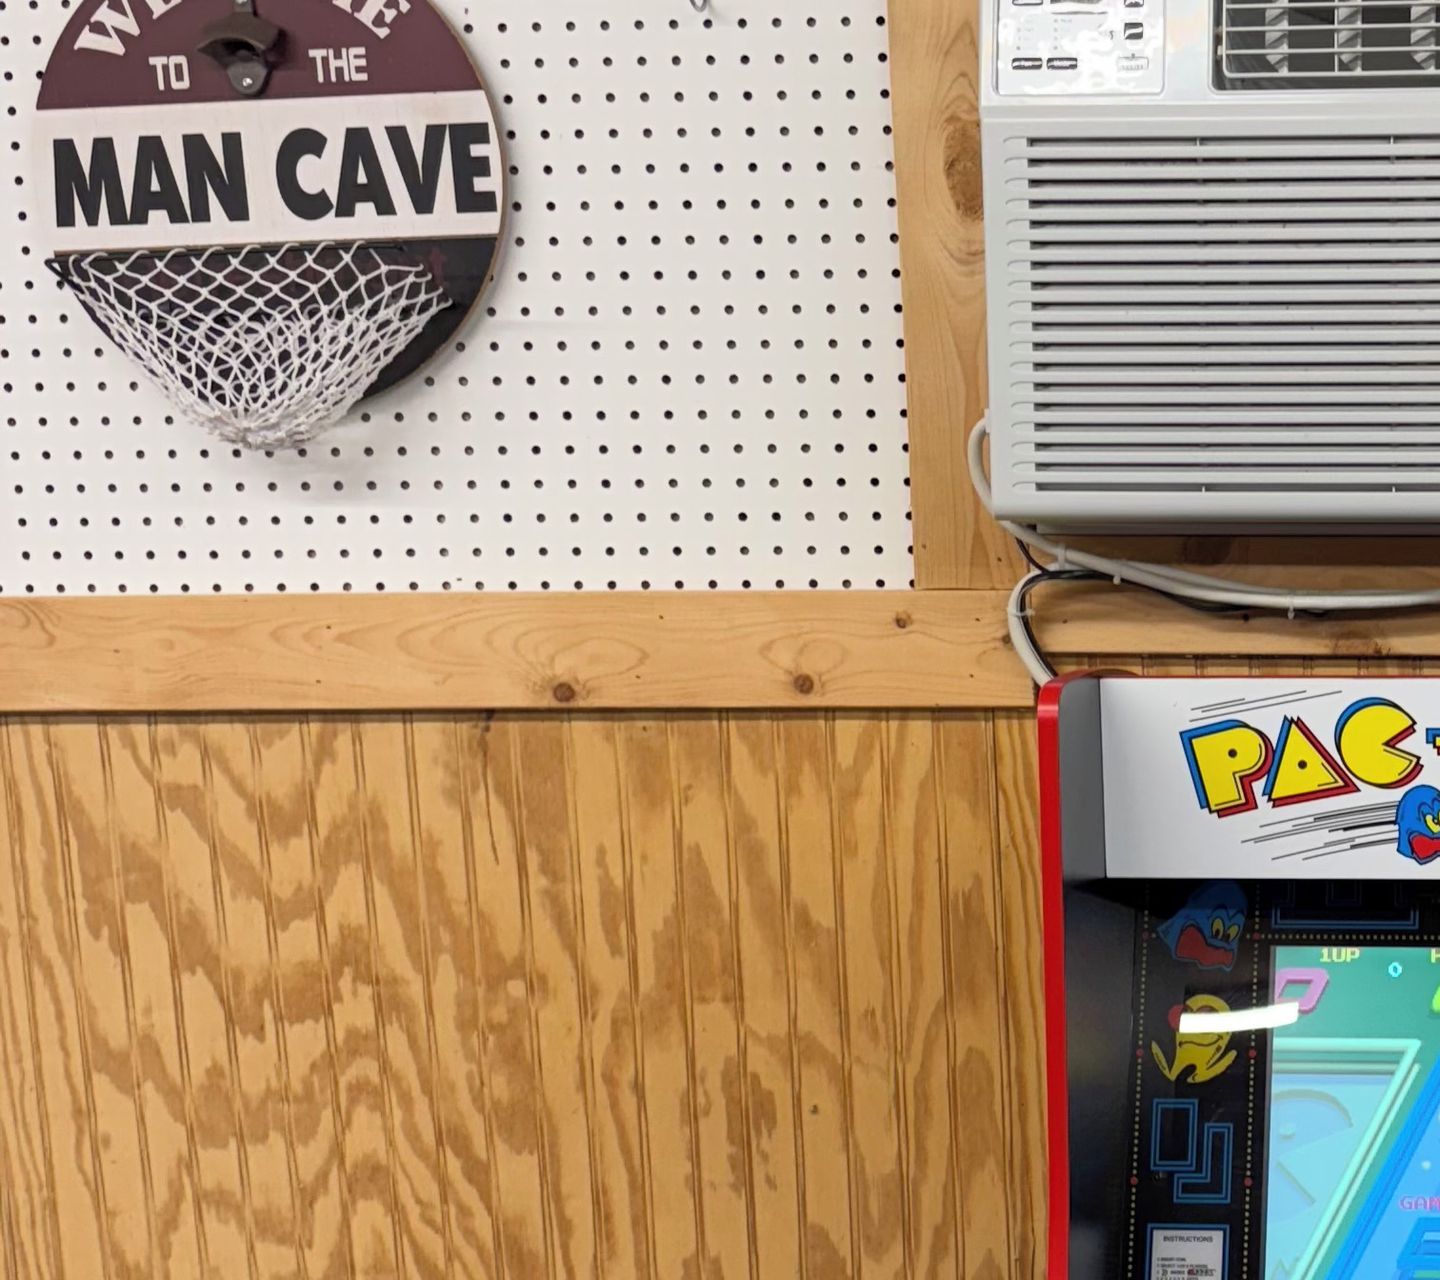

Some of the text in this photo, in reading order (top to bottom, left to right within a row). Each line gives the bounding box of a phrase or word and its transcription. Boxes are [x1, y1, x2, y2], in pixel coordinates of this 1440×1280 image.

[149, 47, 369, 91] TO THE
[53, 121, 498, 228] MAN CAVE
[1320, 947, 1360, 962] 1UP
[1162, 1235, 1214, 1243] INSTRUCTIONS
